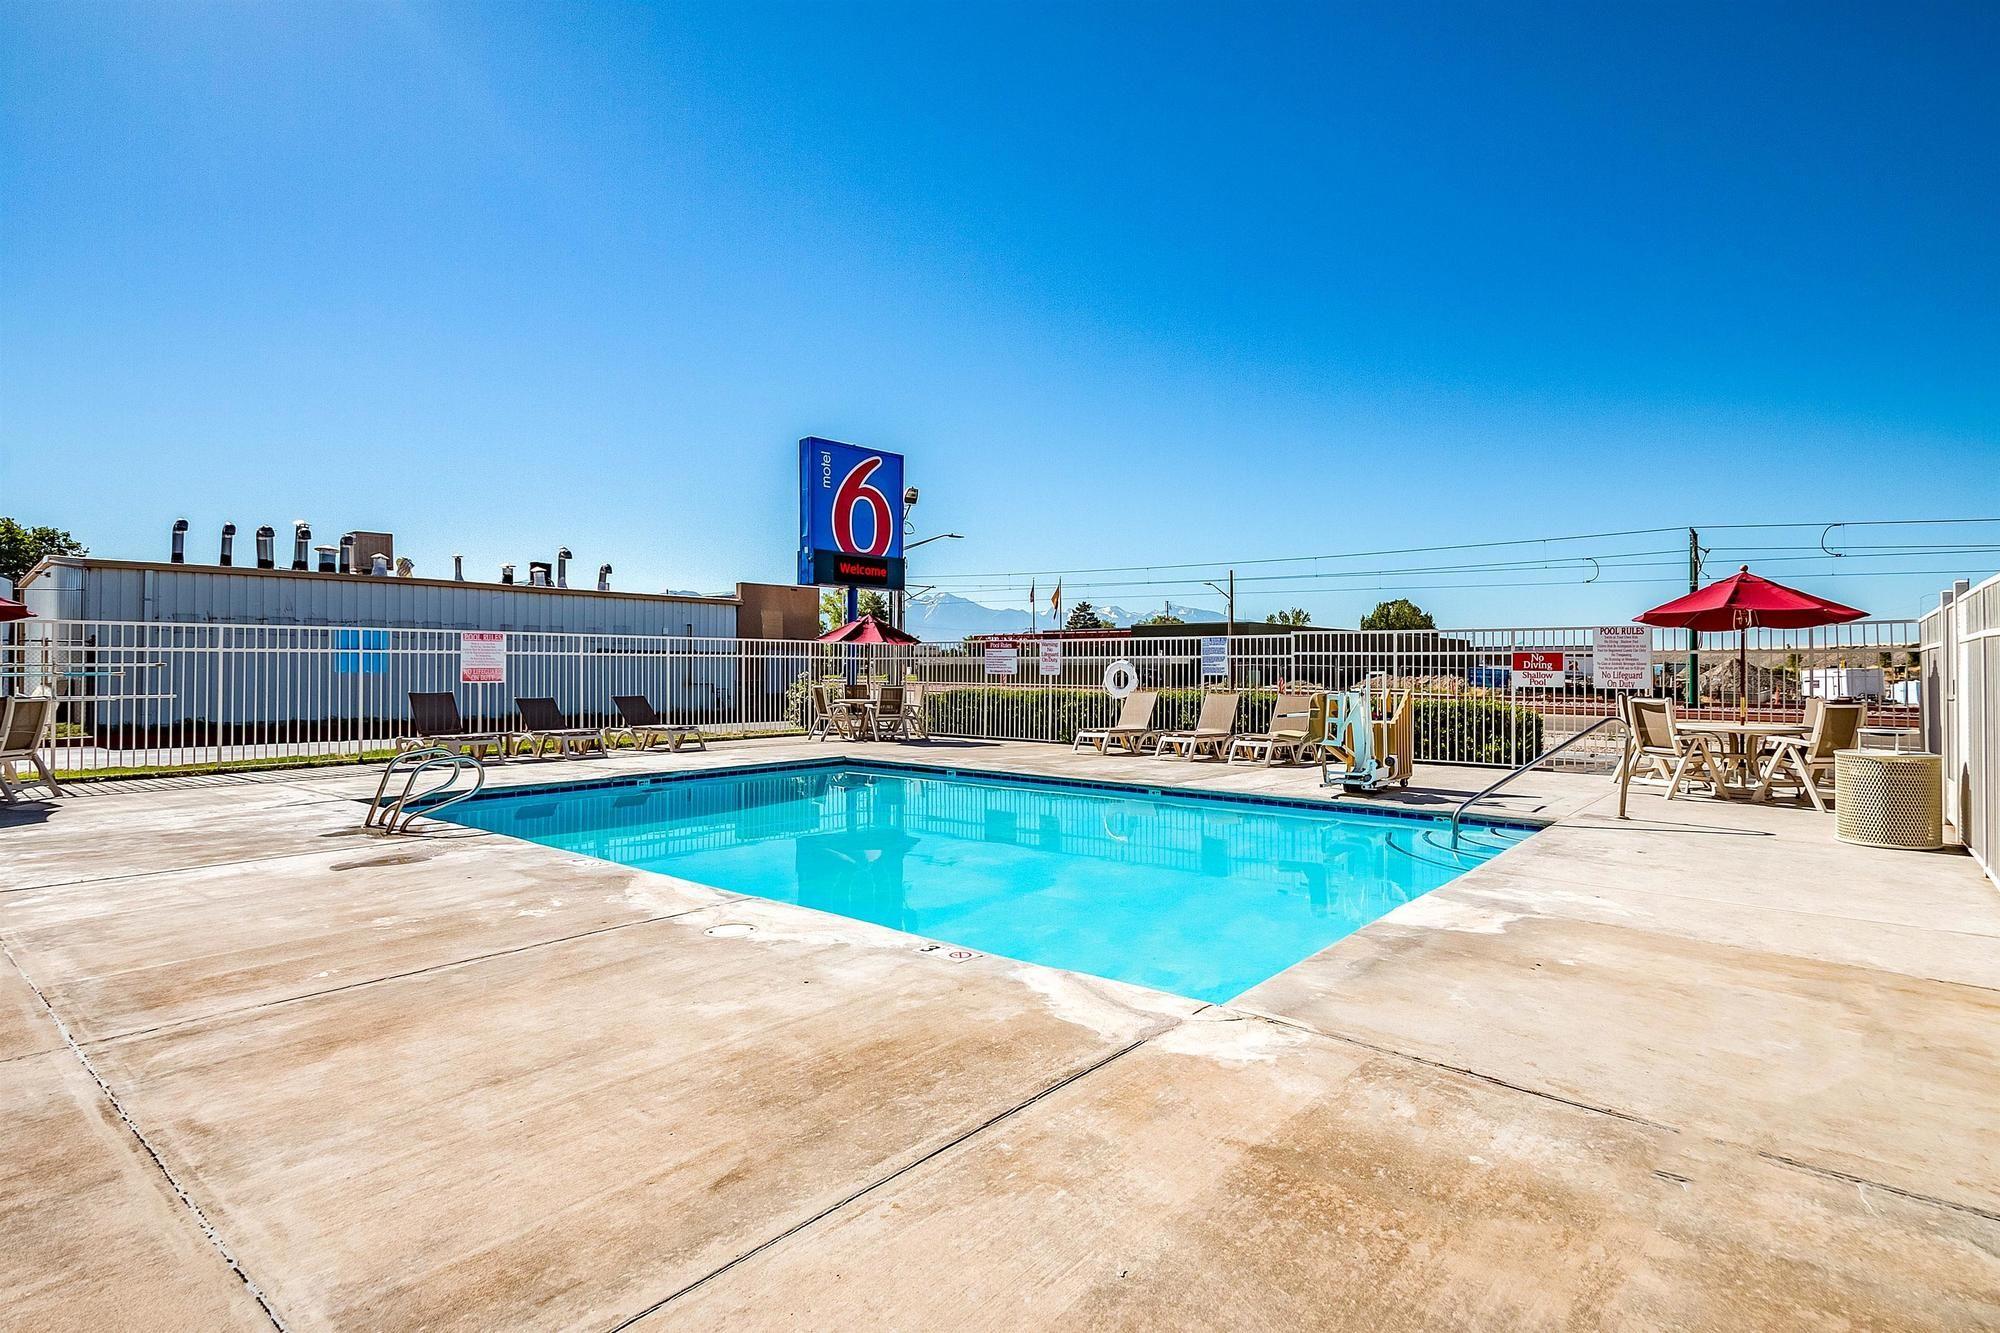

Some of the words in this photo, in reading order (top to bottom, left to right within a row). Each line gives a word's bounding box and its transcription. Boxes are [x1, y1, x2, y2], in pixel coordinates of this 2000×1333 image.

[821, 451, 831, 488] motel
[832, 456, 893, 557] 6
[840, 562, 887, 577] Welcome
[1600, 627, 1619, 635] POOL
[1621, 627, 1645, 635] RULES
[1531, 653, 1544, 662] No
[1523, 660, 1553, 670] Diving
[1522, 671, 1554, 679] Shallow
[1601, 671, 1611, 679] No
[1613, 671, 1643, 681] Lifeguard
[1529, 678, 1546, 686] Pool
[1607, 680, 1617, 688] On
[1619, 680, 1635, 688] Duty
